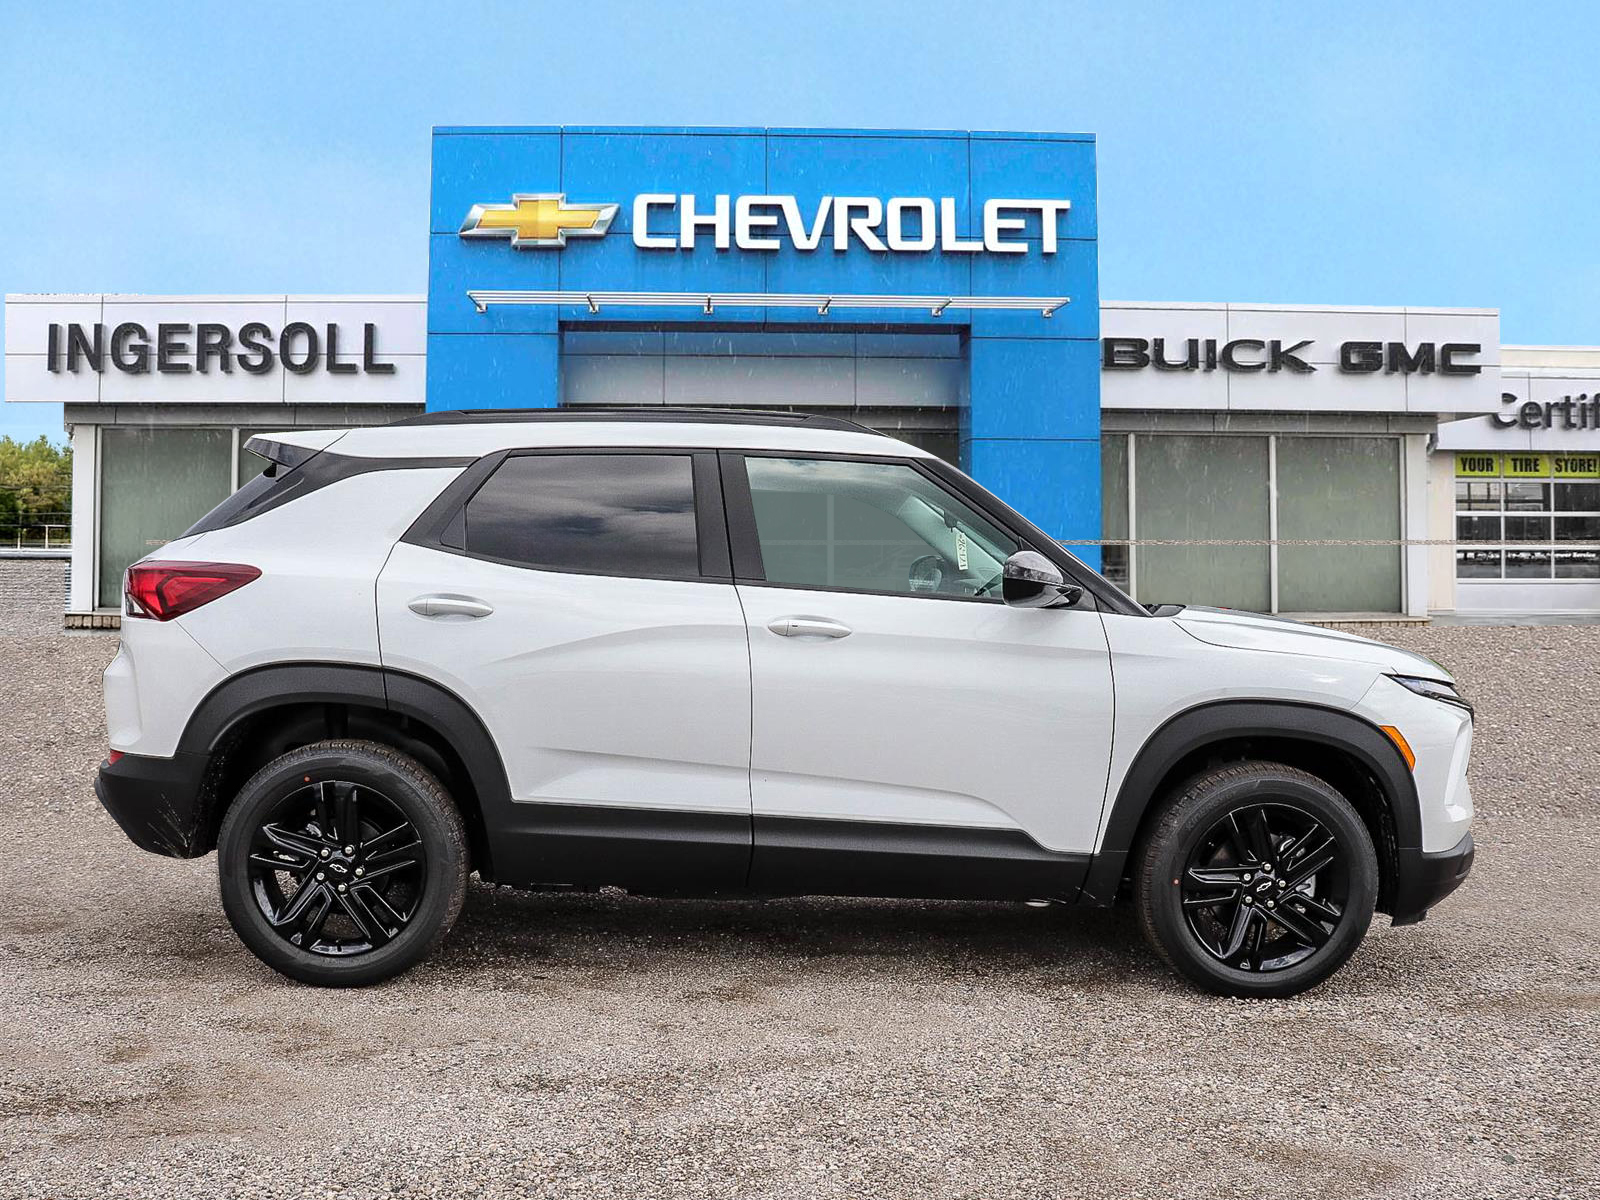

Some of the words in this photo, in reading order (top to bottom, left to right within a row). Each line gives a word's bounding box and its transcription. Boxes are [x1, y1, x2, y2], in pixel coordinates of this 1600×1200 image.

[632, 194, 1071, 253] CHEVROLET
[48, 321, 396, 375] INGERSOLL
[1102, 337, 1317, 373] BUICK
[1340, 341, 1482, 374] GMC
[1461, 457, 1494, 472] YOUR
[1511, 457, 1540, 472] TIRE
[1554, 458, 1597, 473] STORE!
